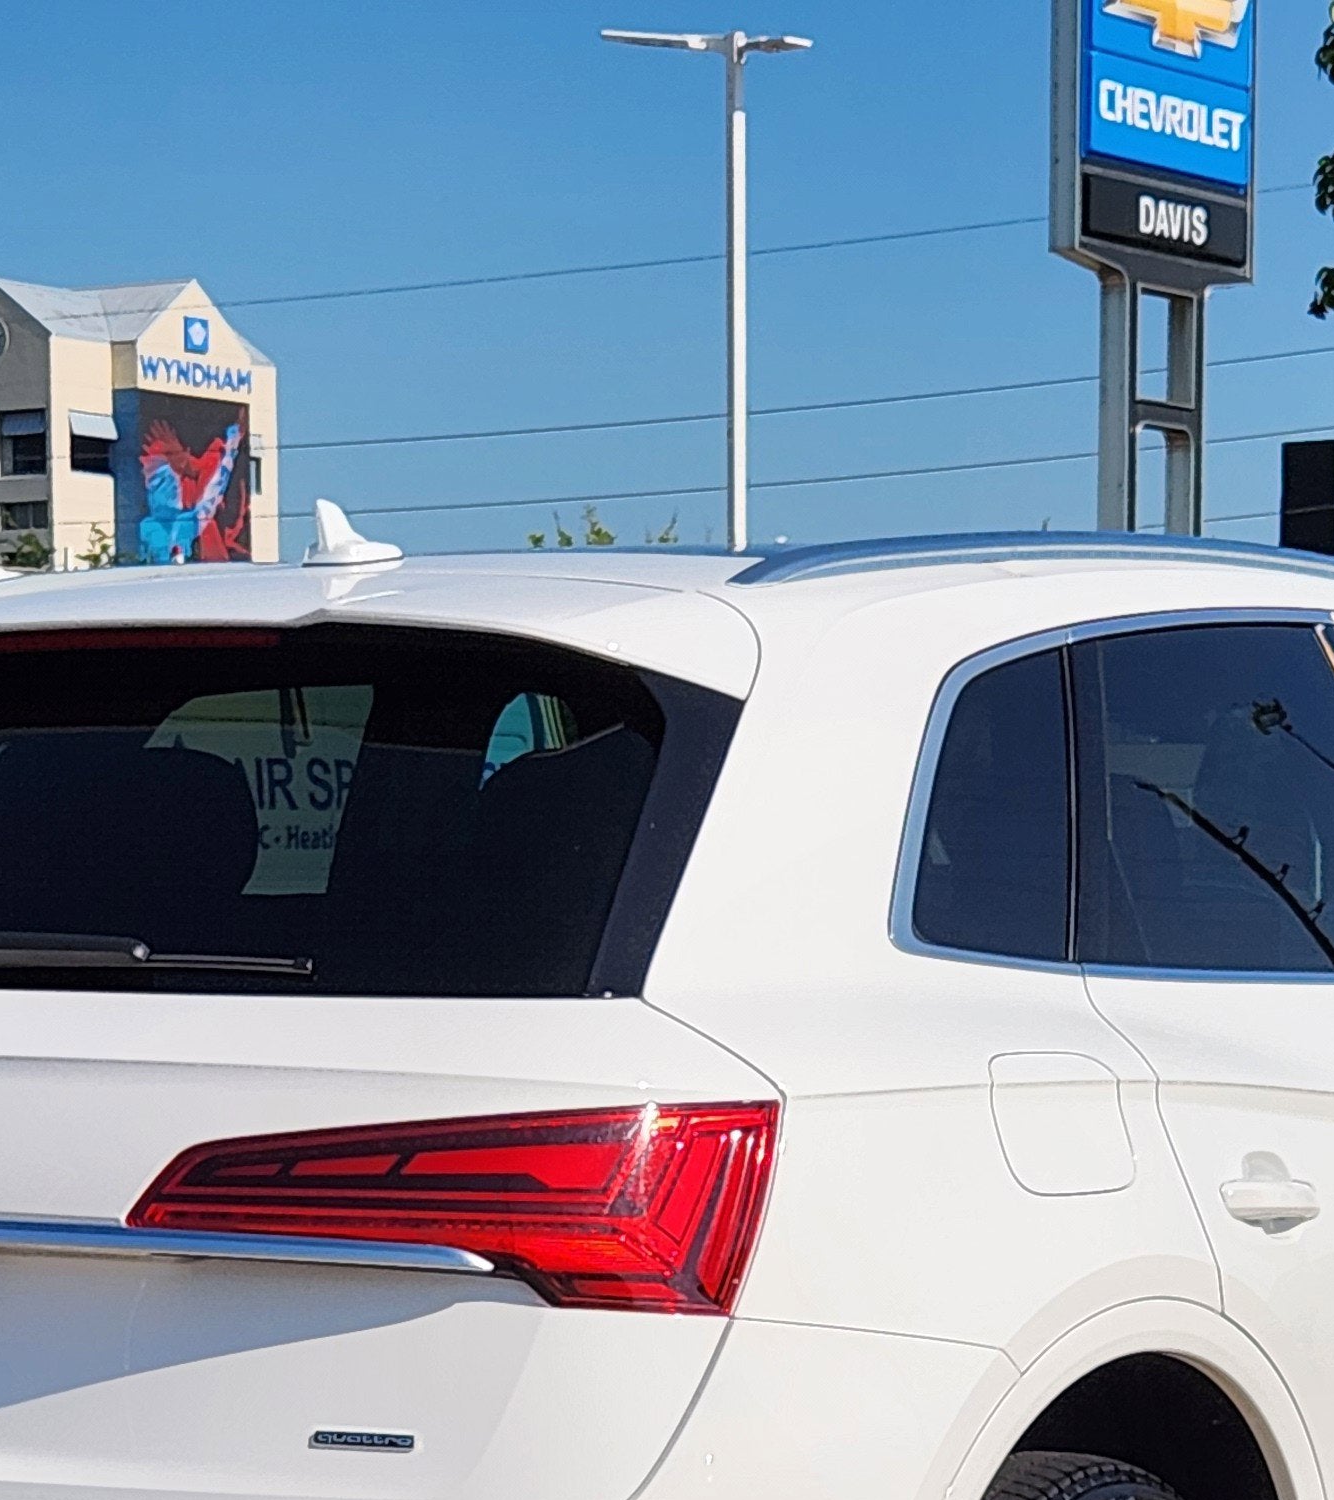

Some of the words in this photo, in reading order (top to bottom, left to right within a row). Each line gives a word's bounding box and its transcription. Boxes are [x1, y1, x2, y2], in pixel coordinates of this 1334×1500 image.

[1098, 78, 1247, 151] CHEVROLET
[1138, 194, 1209, 246] DAVIS
[139, 354, 252, 394] WYNDHAM
[317, 1432, 413, 1446] quattro
